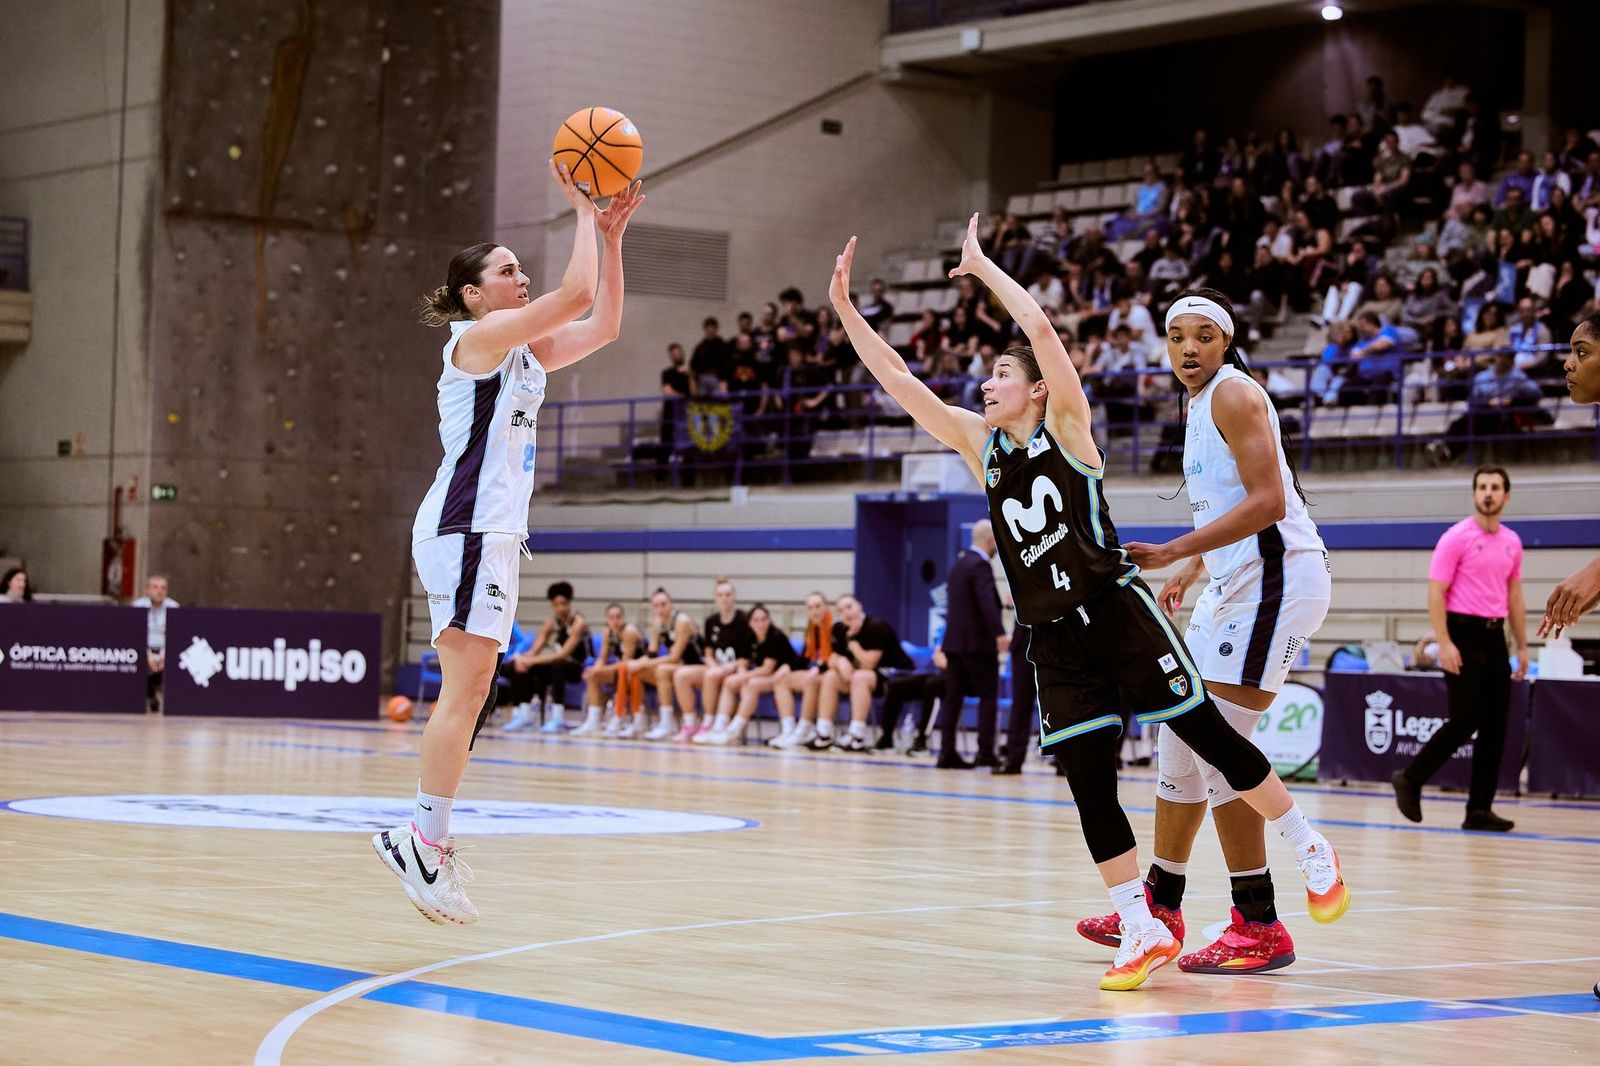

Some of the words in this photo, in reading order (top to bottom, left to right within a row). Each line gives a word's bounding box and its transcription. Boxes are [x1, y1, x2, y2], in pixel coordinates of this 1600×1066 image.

[1050, 563, 1072, 591] 4
[9, 642, 67, 662] ÓPTICA
[68, 646, 139, 664] SORIANO
[225, 637, 367, 692] unipiso
